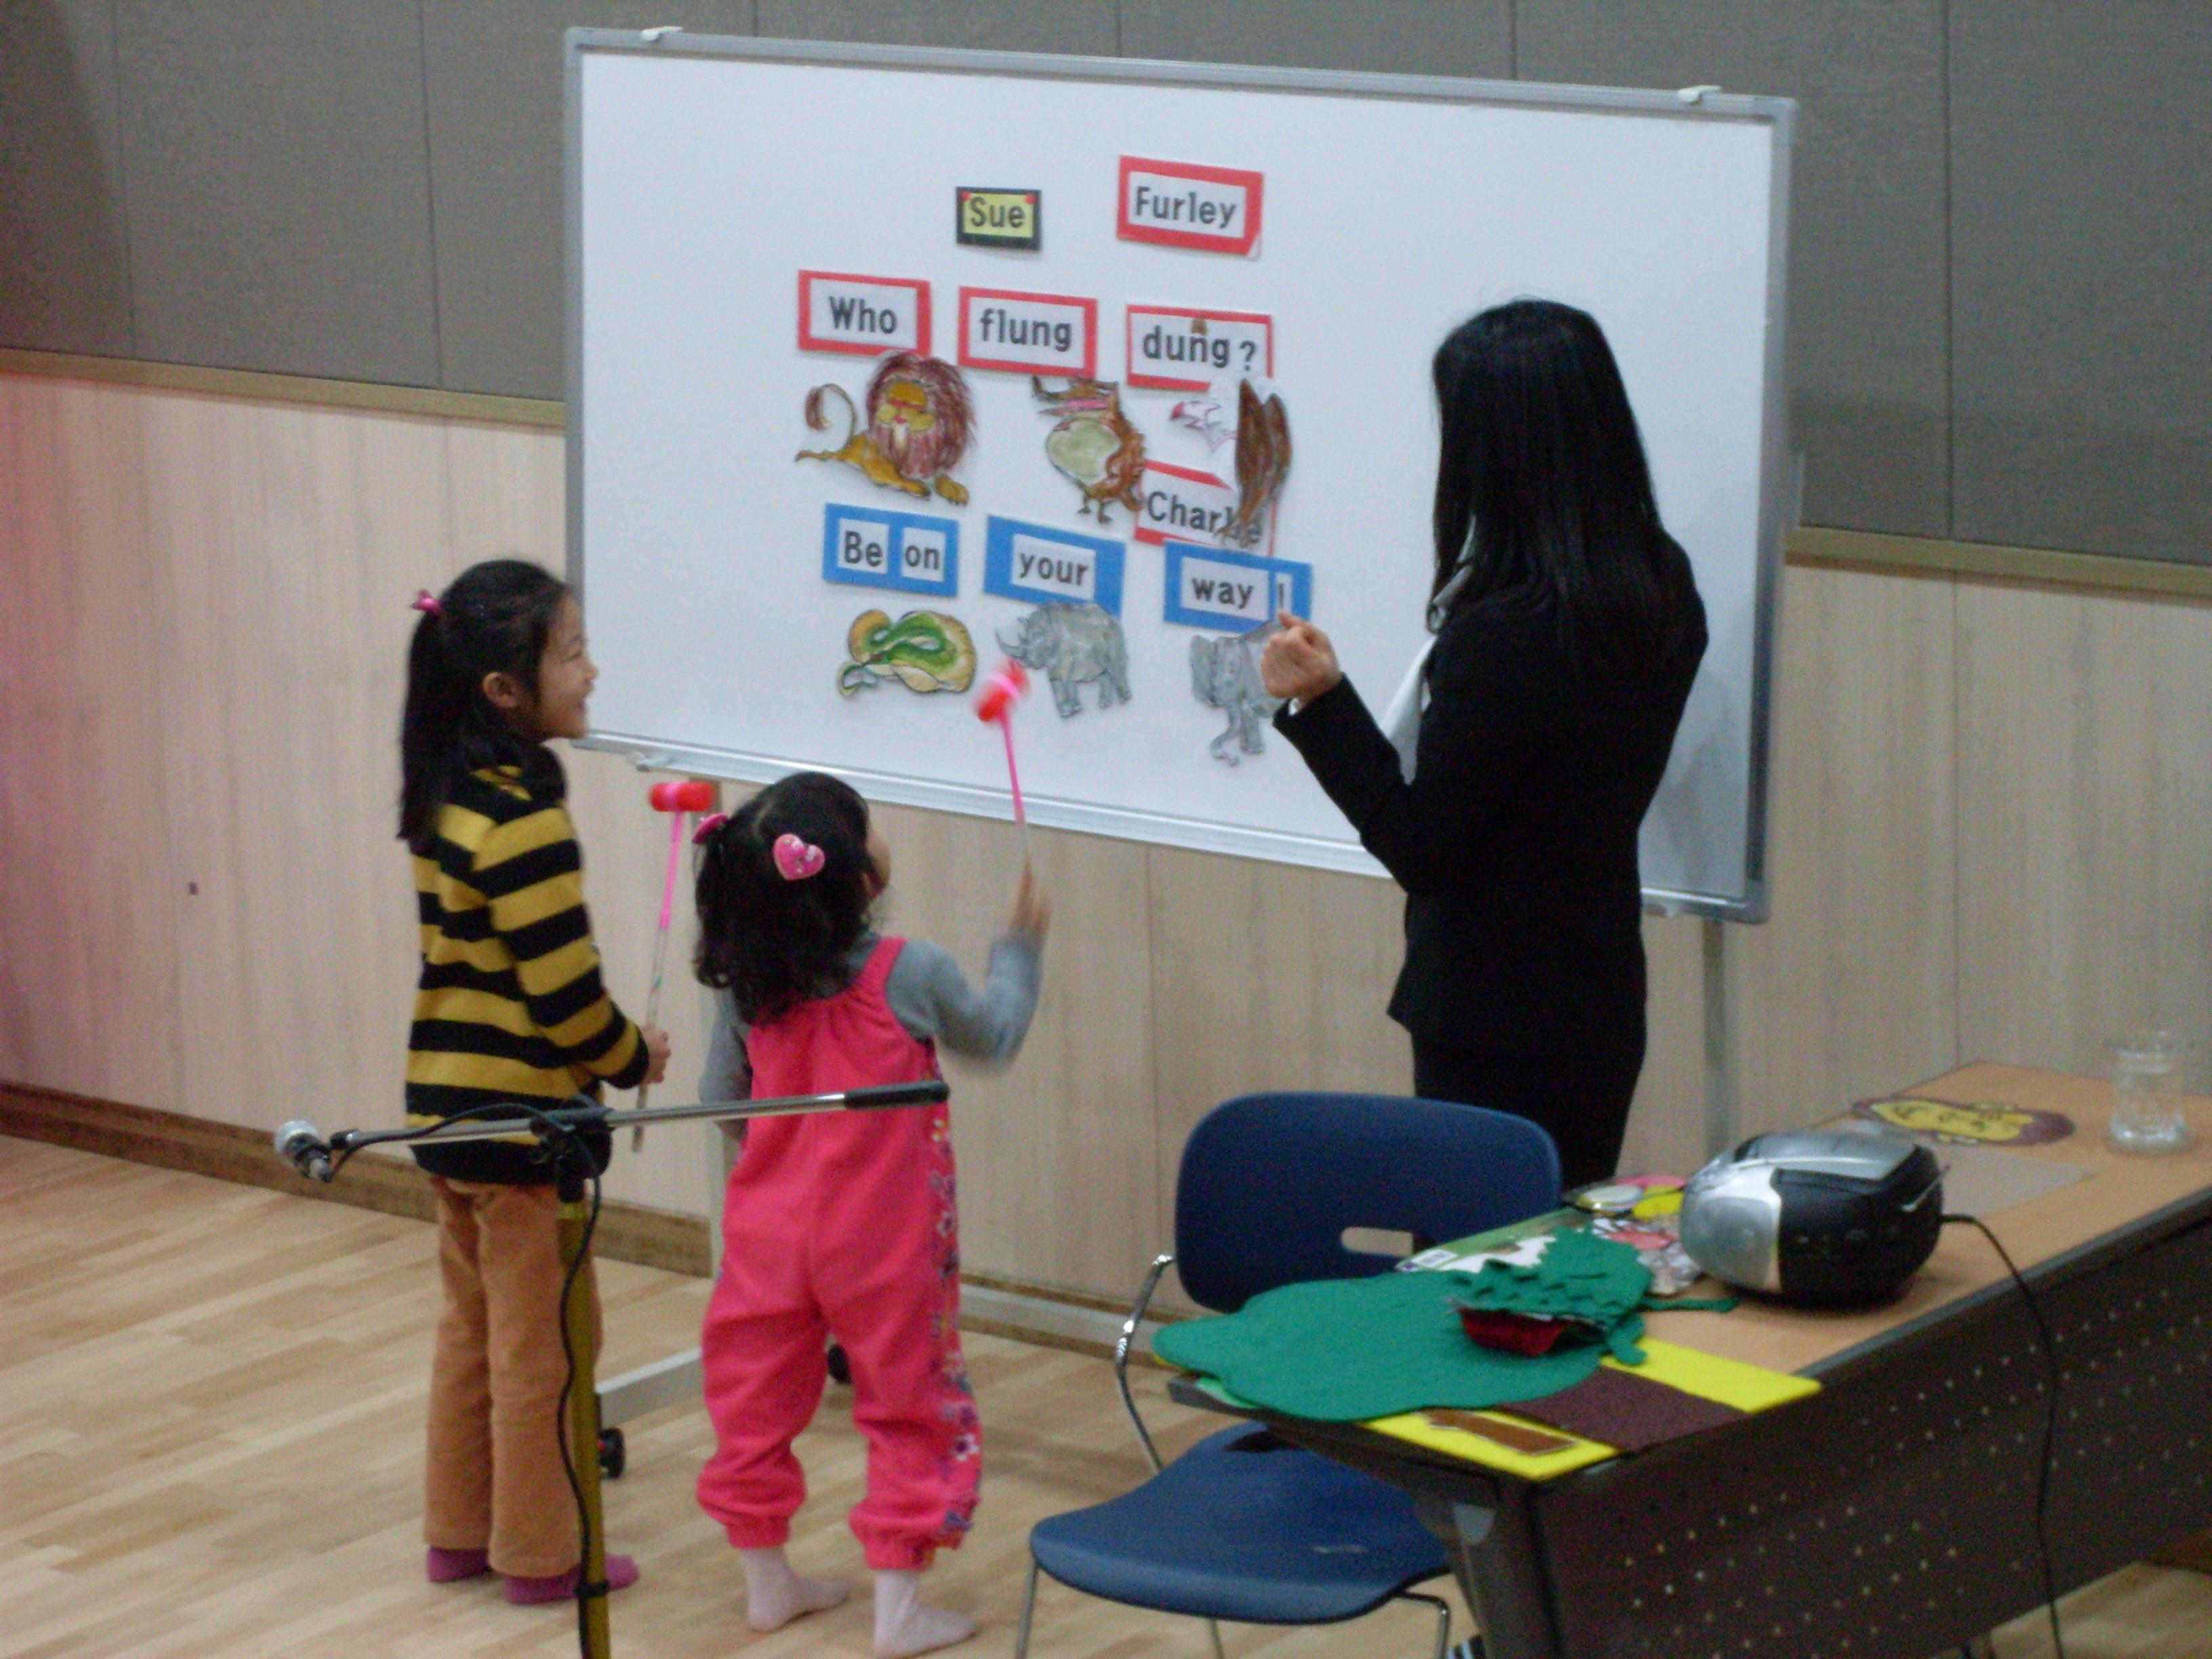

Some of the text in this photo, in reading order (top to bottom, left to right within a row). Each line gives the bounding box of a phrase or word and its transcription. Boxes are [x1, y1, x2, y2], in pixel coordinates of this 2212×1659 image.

[970, 196, 1025, 229] Sue
[1134, 186, 1236, 229] Furley
[829, 295, 898, 335] Who
[979, 309, 1073, 352] flung
[844, 531, 882, 567] Be
[905, 544, 940, 571] on
[1019, 552, 1089, 587] your
[1192, 577, 1254, 610] way
